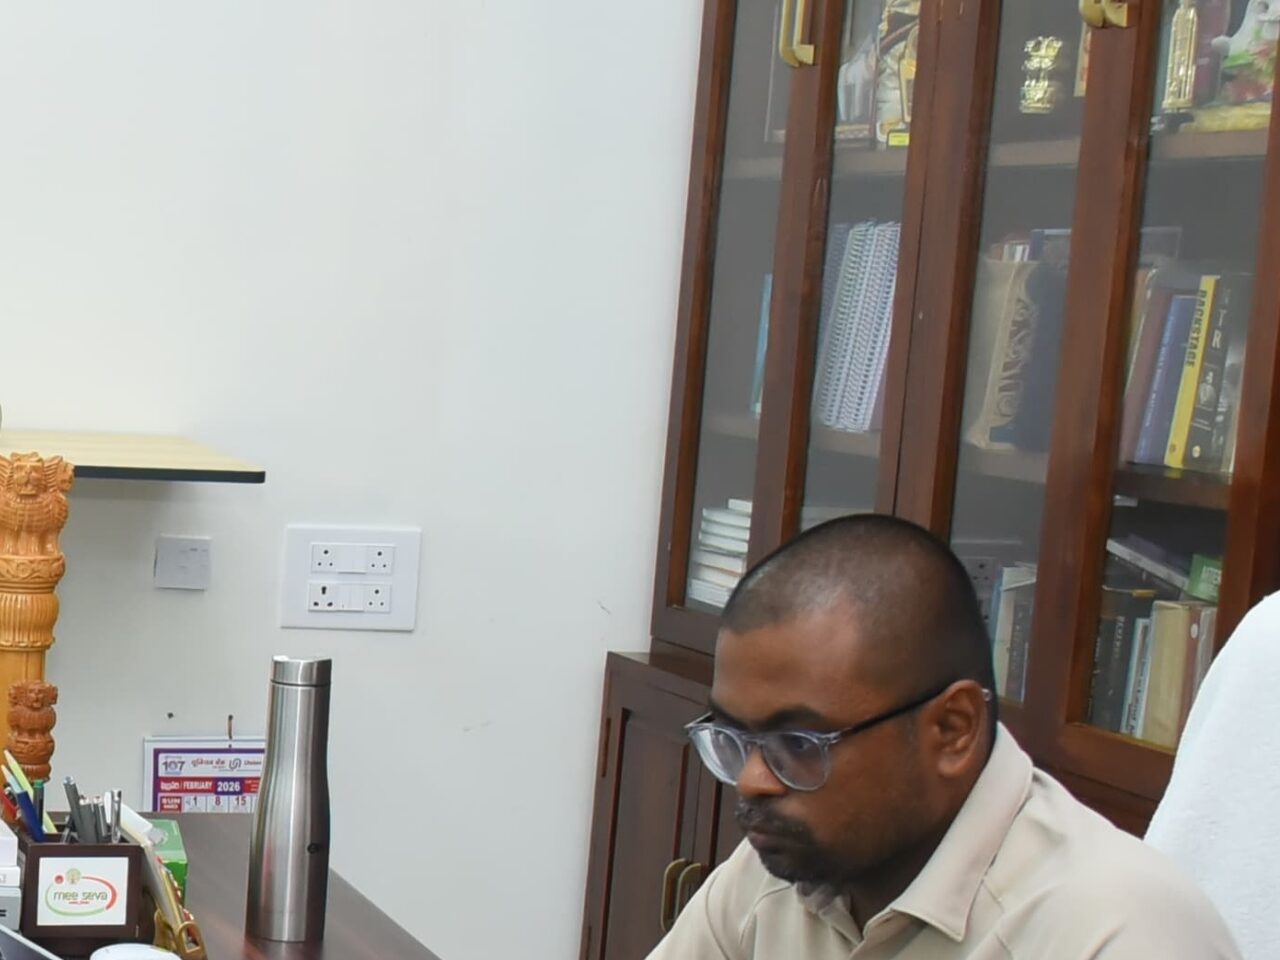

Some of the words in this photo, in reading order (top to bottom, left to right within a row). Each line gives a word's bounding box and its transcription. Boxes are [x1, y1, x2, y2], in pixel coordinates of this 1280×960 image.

[183, 781, 213, 790] FEBRUARY
[217, 781, 241, 792] 2026
[236, 796, 247, 806] 15
[54, 891, 79, 901] mee
[82, 891, 108, 901] seva
